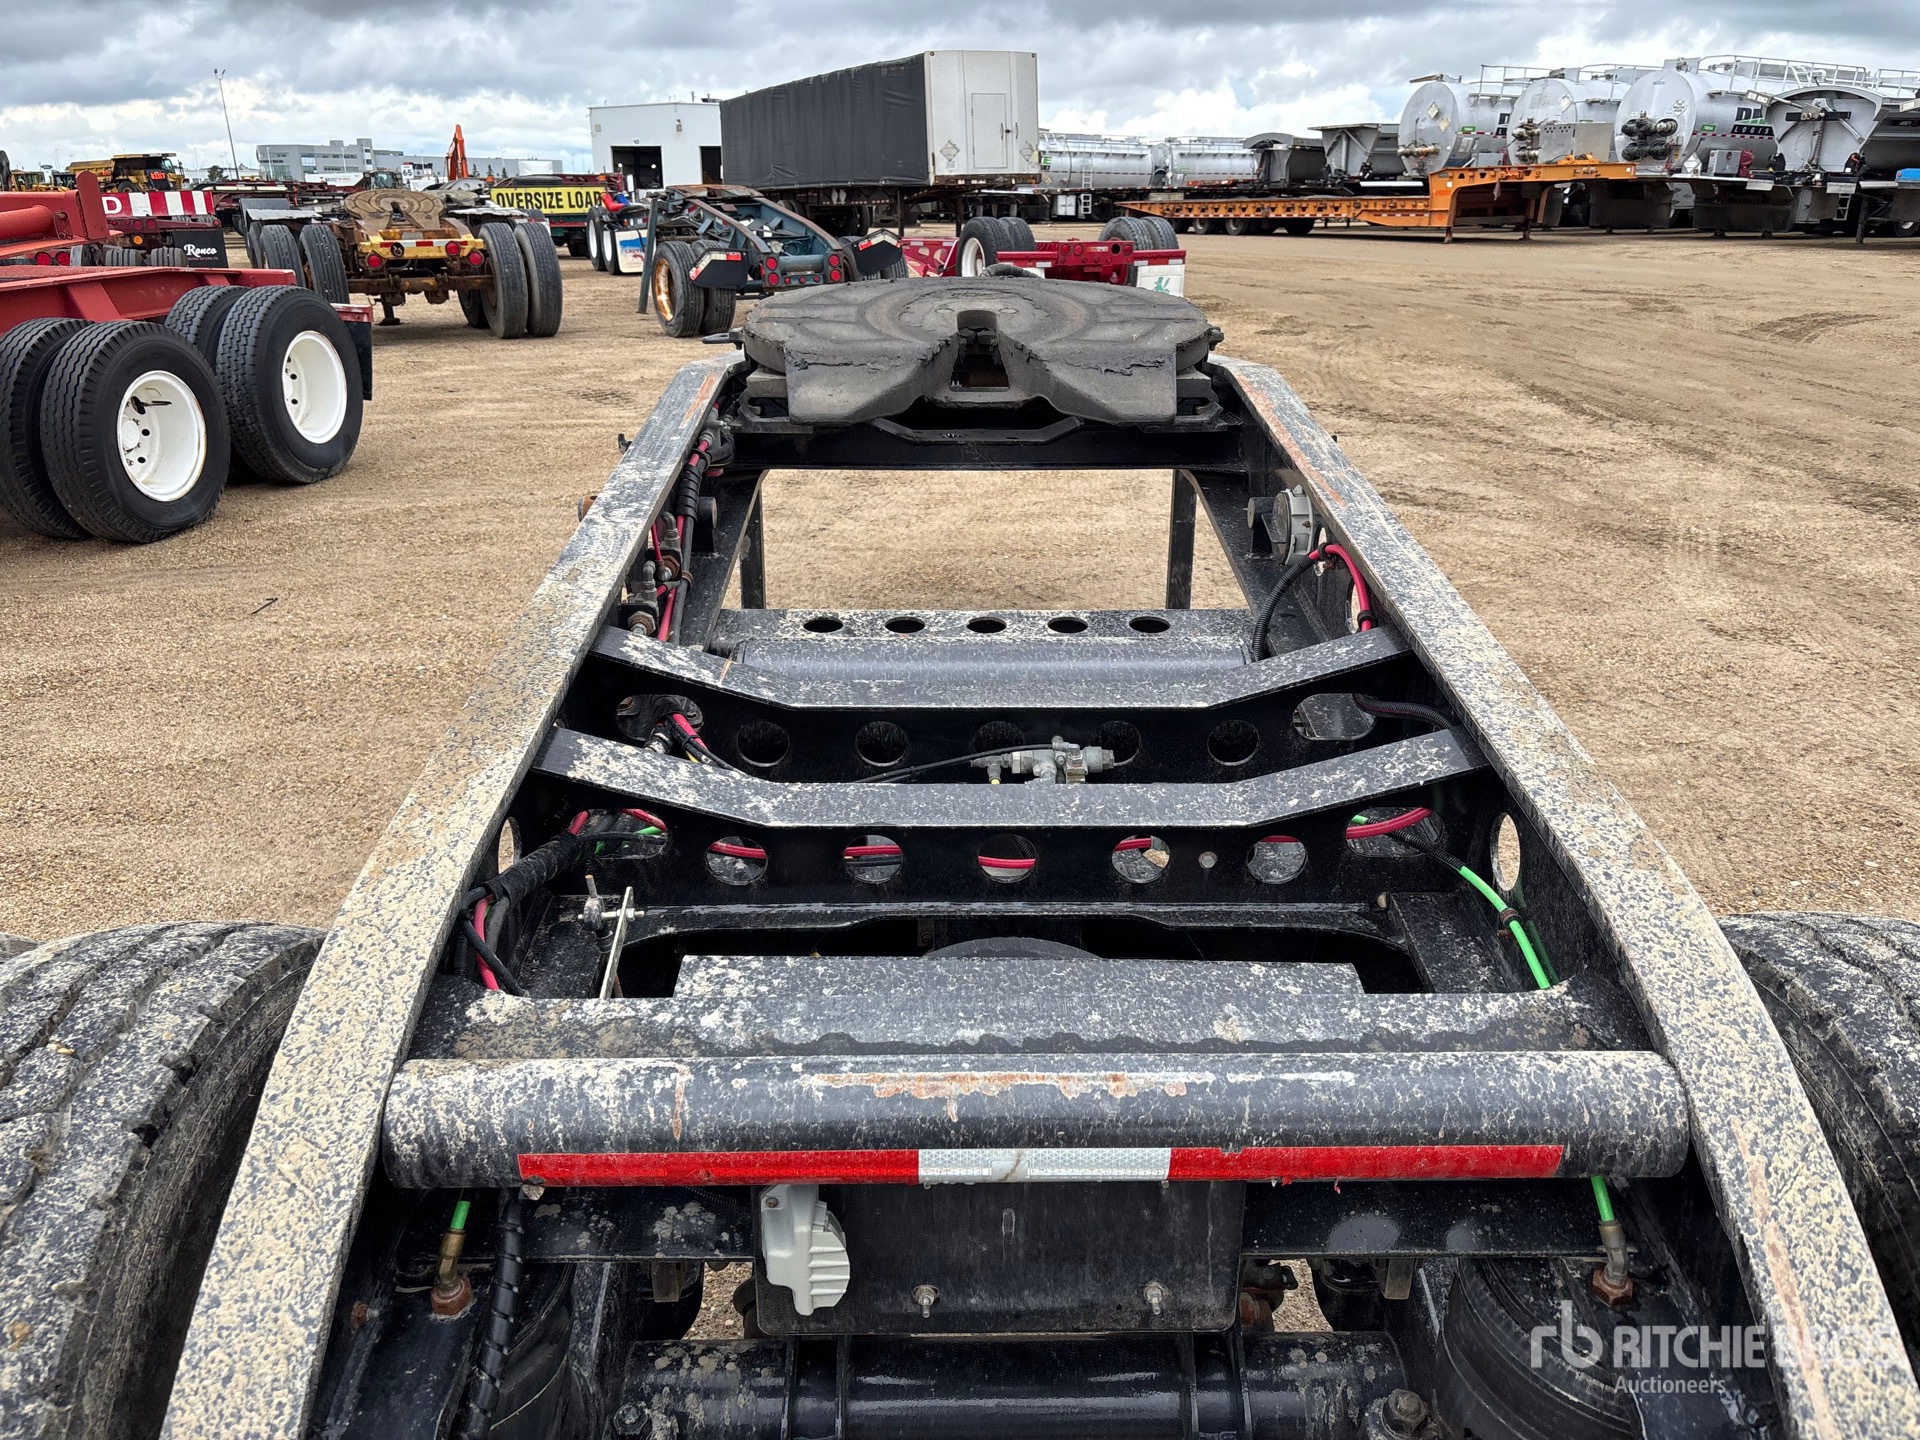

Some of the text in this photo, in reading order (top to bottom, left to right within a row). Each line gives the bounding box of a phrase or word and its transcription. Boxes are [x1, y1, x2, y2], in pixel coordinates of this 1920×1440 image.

[402, 169, 413, 177] 65
[496, 191, 602, 210] OVERSIZE LOAD
[183, 243, 217, 258] Ronco
